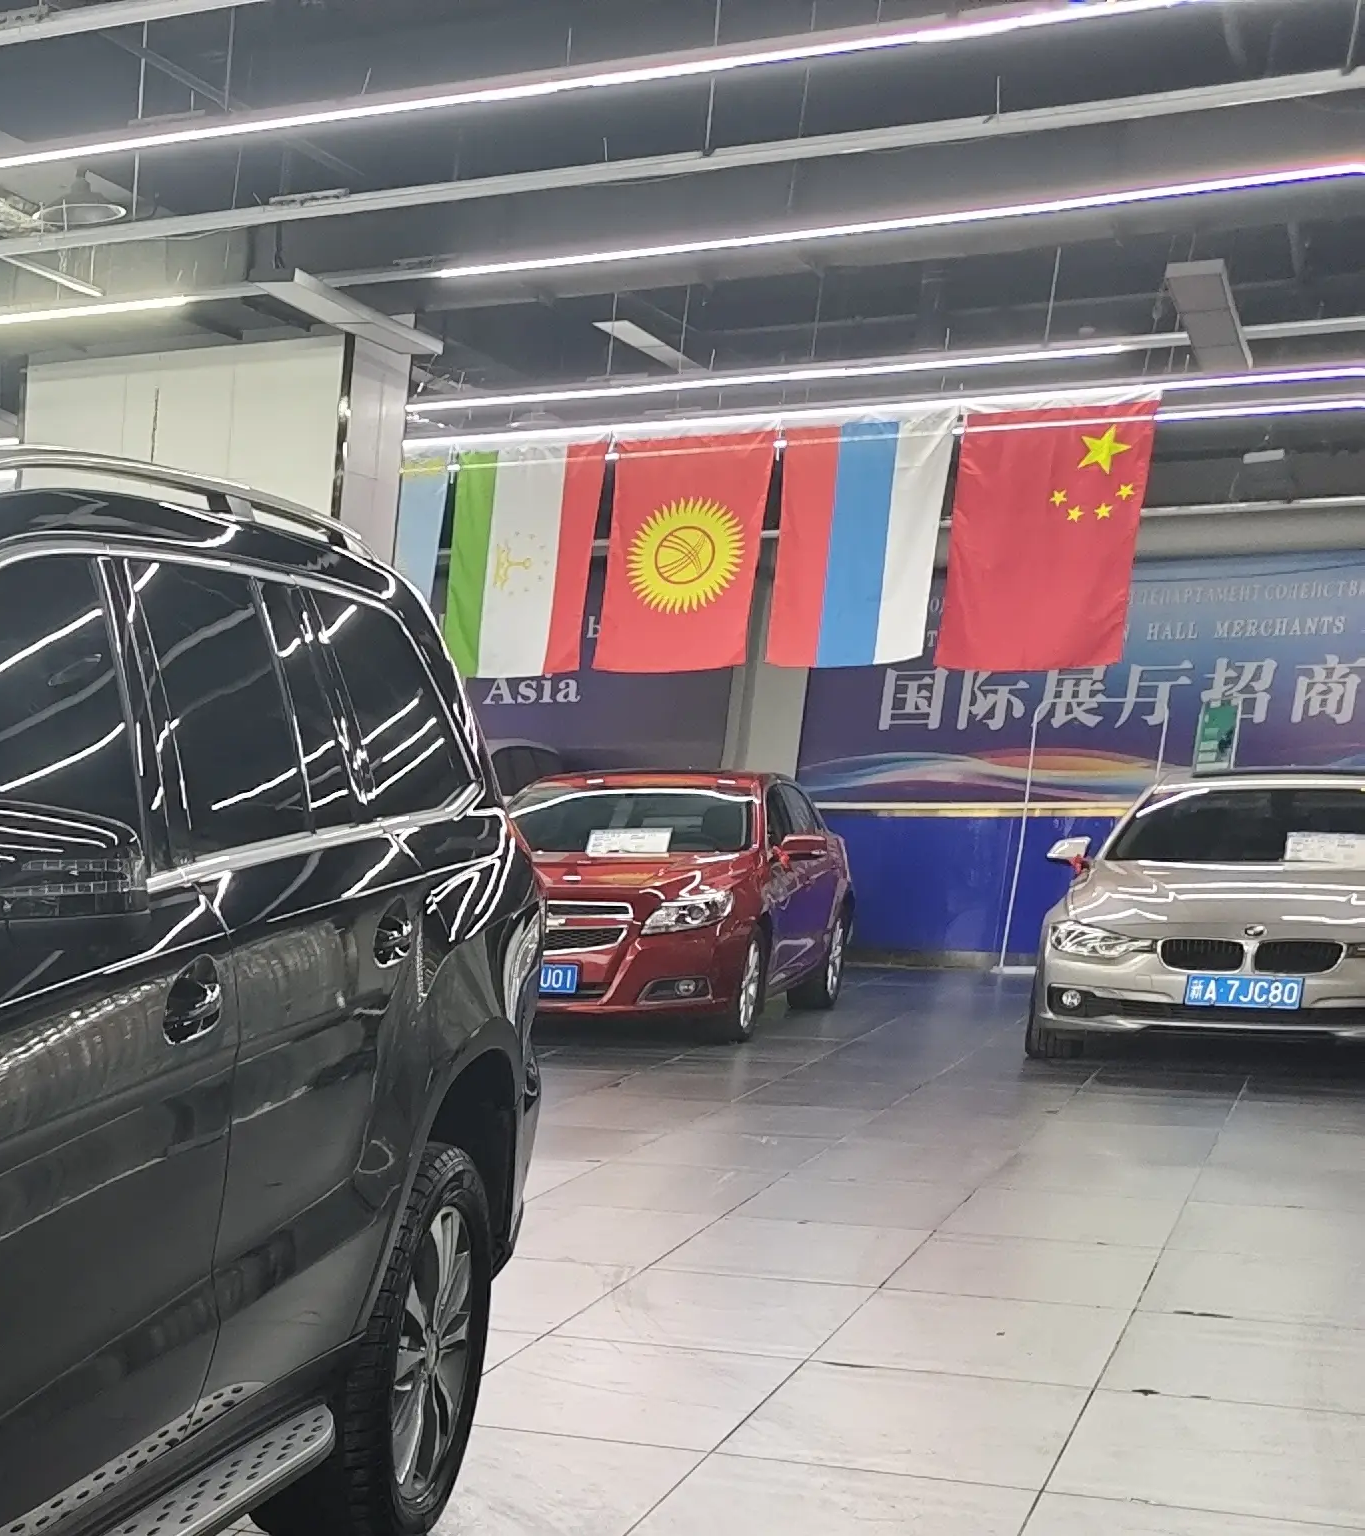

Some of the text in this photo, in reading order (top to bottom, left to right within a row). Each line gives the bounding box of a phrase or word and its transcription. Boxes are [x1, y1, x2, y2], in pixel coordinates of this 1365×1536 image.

[1146, 620, 1199, 641] HALL
[1214, 615, 1346, 639] MERCHANTS
[482, 674, 581, 705] Asia
[878, 654, 1365, 731] 国际展厅招商
